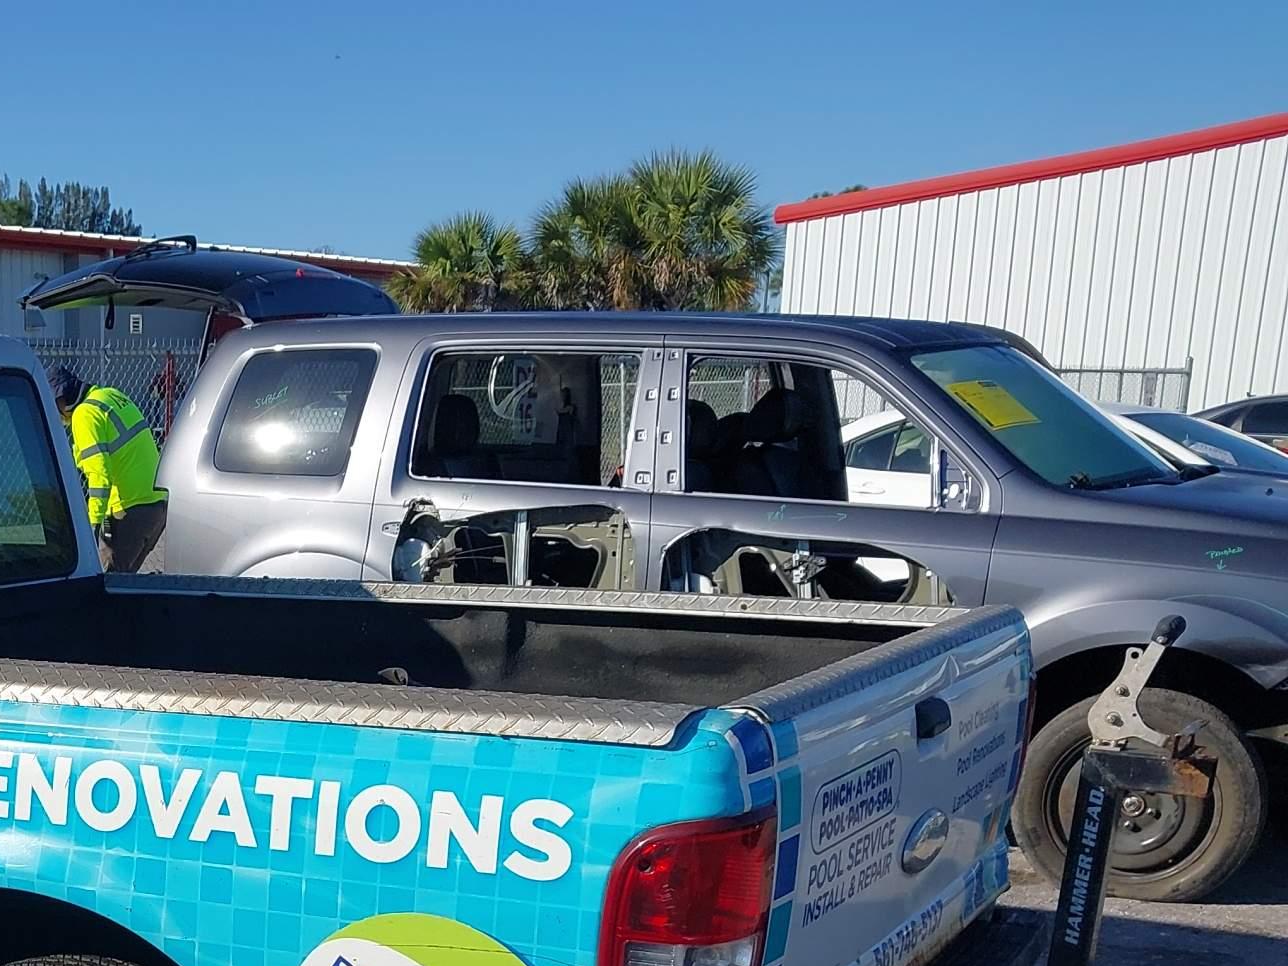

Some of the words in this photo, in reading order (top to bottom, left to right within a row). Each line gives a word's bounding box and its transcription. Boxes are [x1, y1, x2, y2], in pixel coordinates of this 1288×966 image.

[956, 750, 971, 777] Pool
[801, 880, 846, 929] INSTALL
[847, 874, 857, 899] &
[856, 851, 893, 894] REPAIR
[807, 848, 844, 896] POOL
[846, 816, 897, 872] SERVICE
